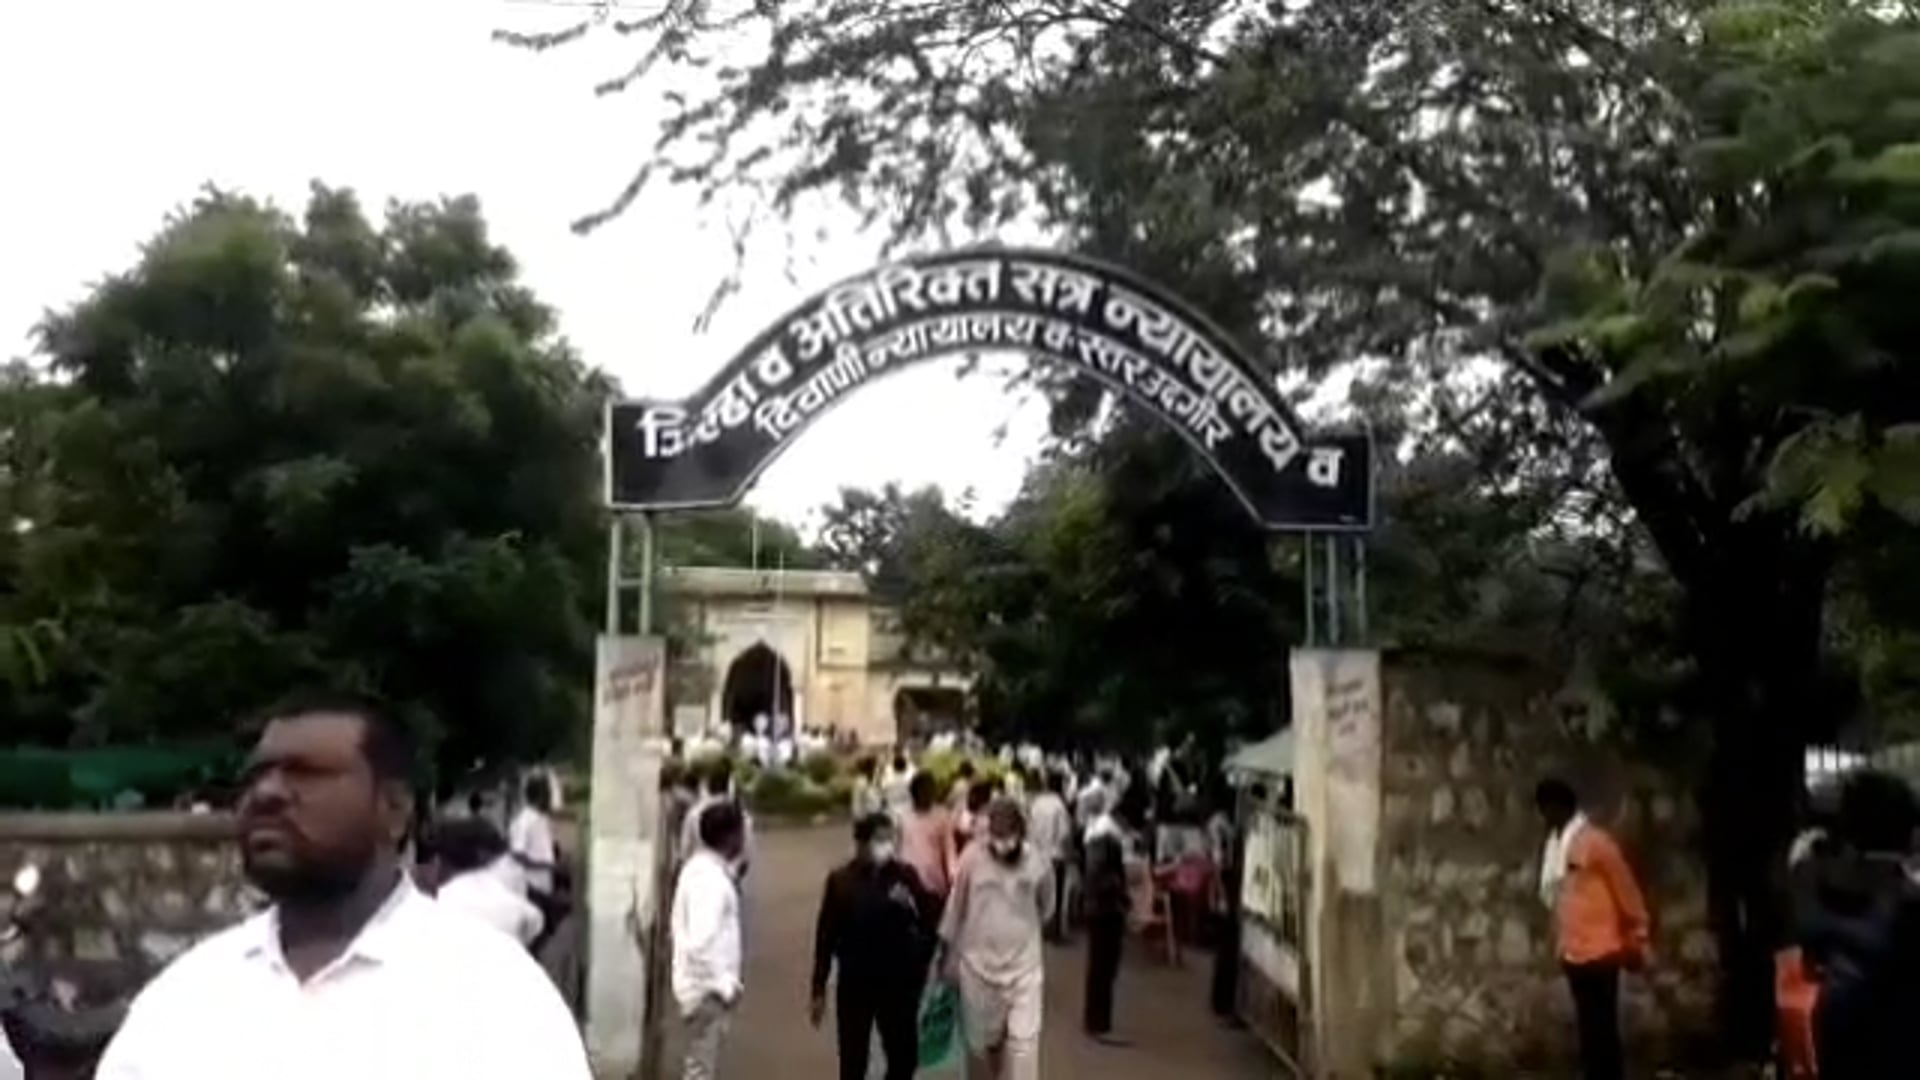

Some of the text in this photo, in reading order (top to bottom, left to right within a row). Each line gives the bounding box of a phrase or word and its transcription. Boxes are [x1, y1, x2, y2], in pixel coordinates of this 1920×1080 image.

[752, 341, 794, 386] व
[789, 261, 1001, 360] अतिरिक्त
[1009, 261, 1104, 313] सत्र
[1103, 283, 1301, 471] न्यायालय
[1306, 447, 1345, 488] व
[754, 341, 866, 441] दिवाणी
[863, 312, 1044, 367] न्यायालय
